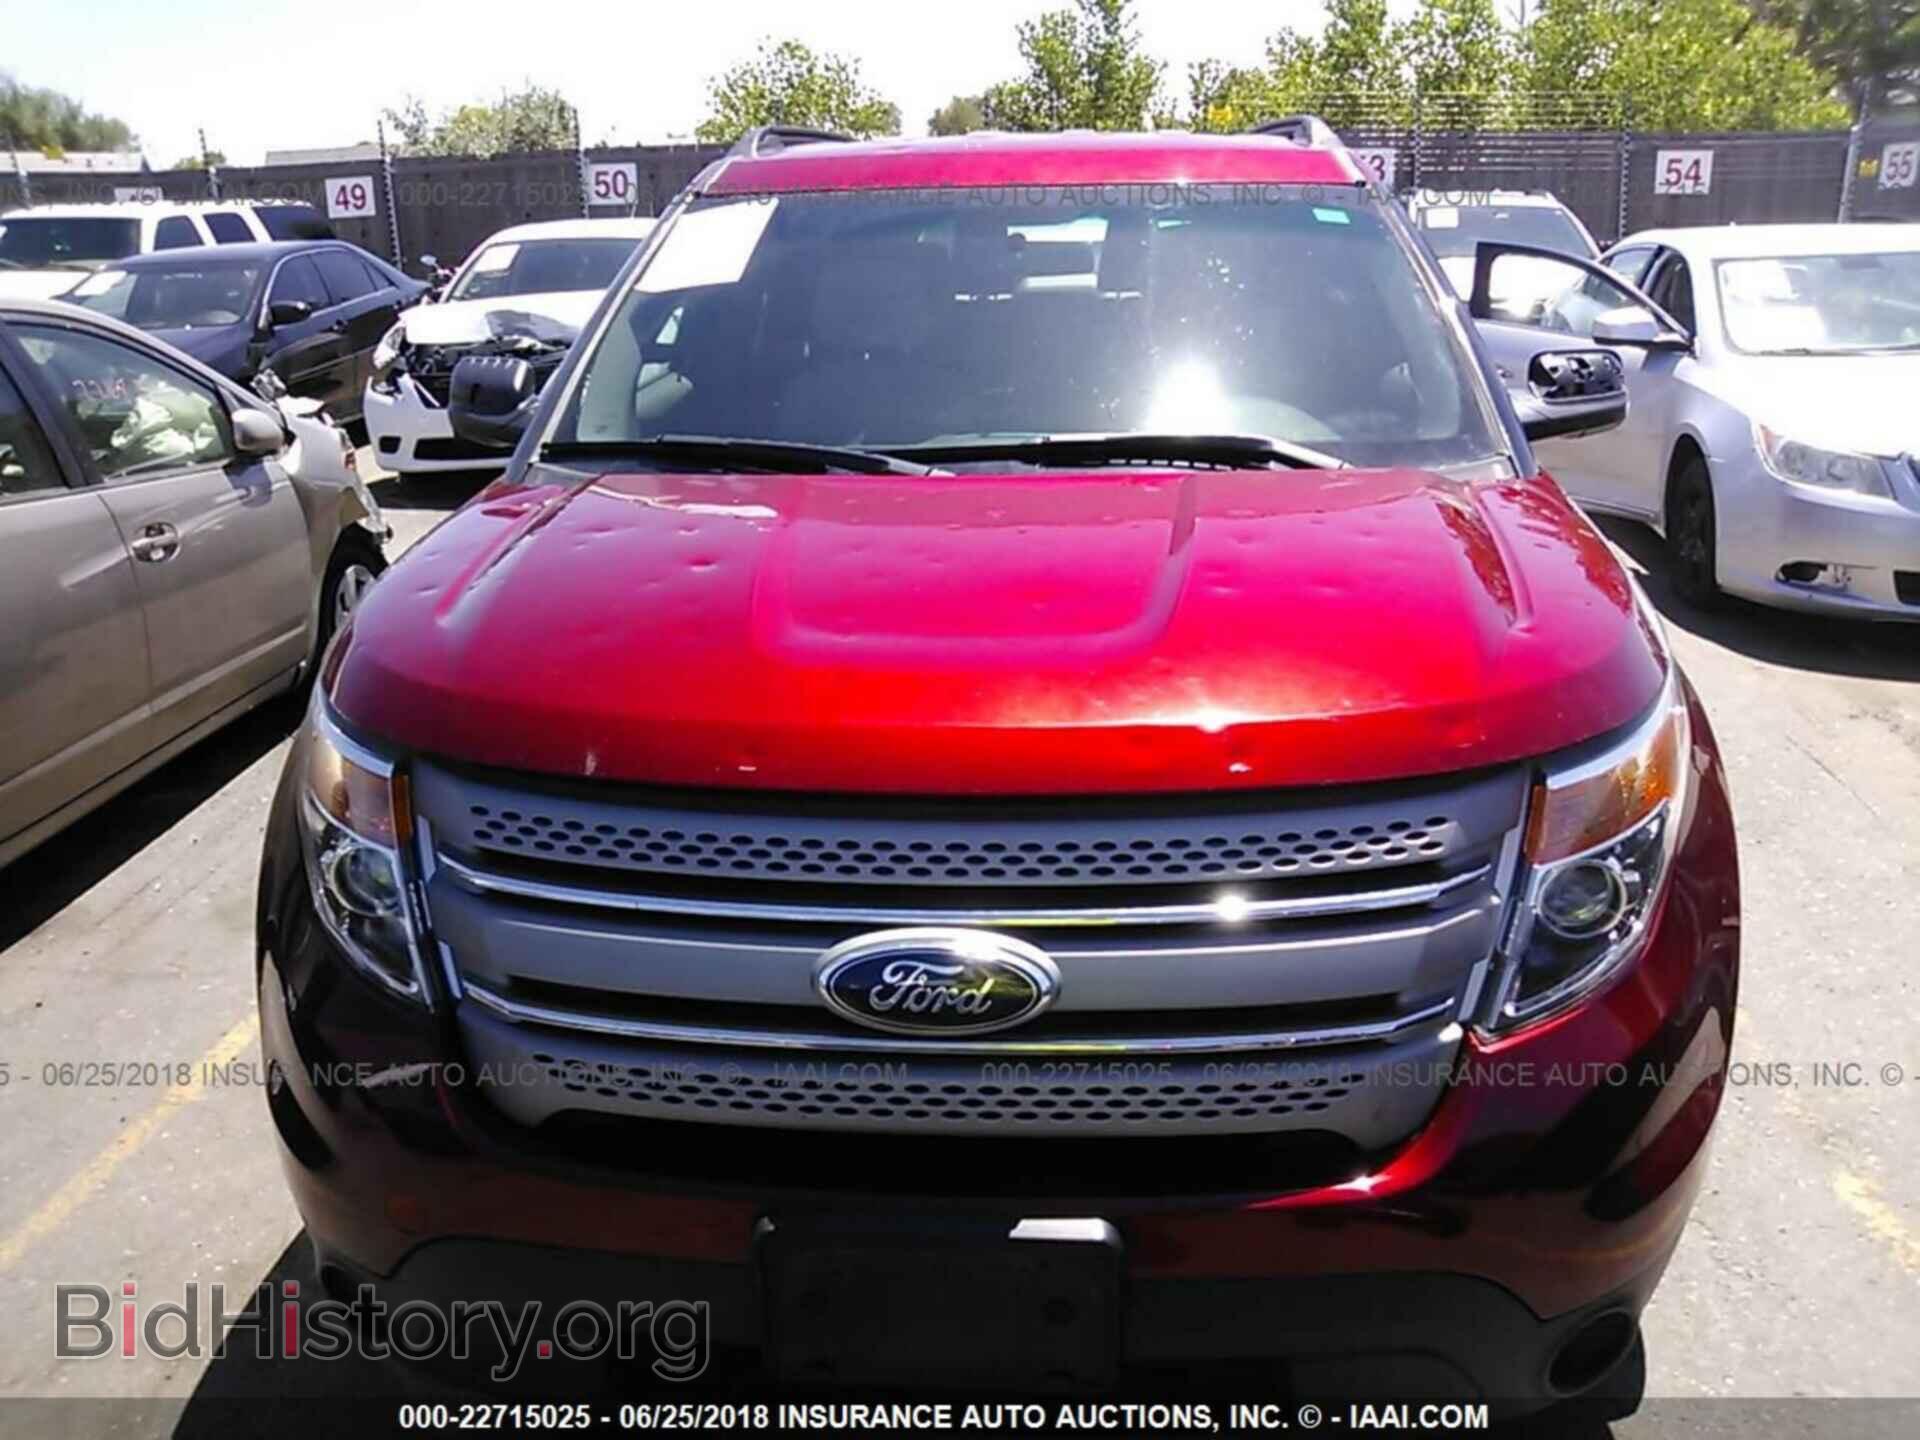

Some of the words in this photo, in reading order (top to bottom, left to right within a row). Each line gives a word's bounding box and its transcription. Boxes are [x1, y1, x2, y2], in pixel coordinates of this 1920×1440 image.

[1361, 154, 1385, 181] 3
[1665, 158, 1702, 188] 54
[1887, 151, 1913, 180] 55
[335, 184, 366, 211] 49
[594, 169, 629, 199] 50
[869, 960, 996, 1014] Ford
